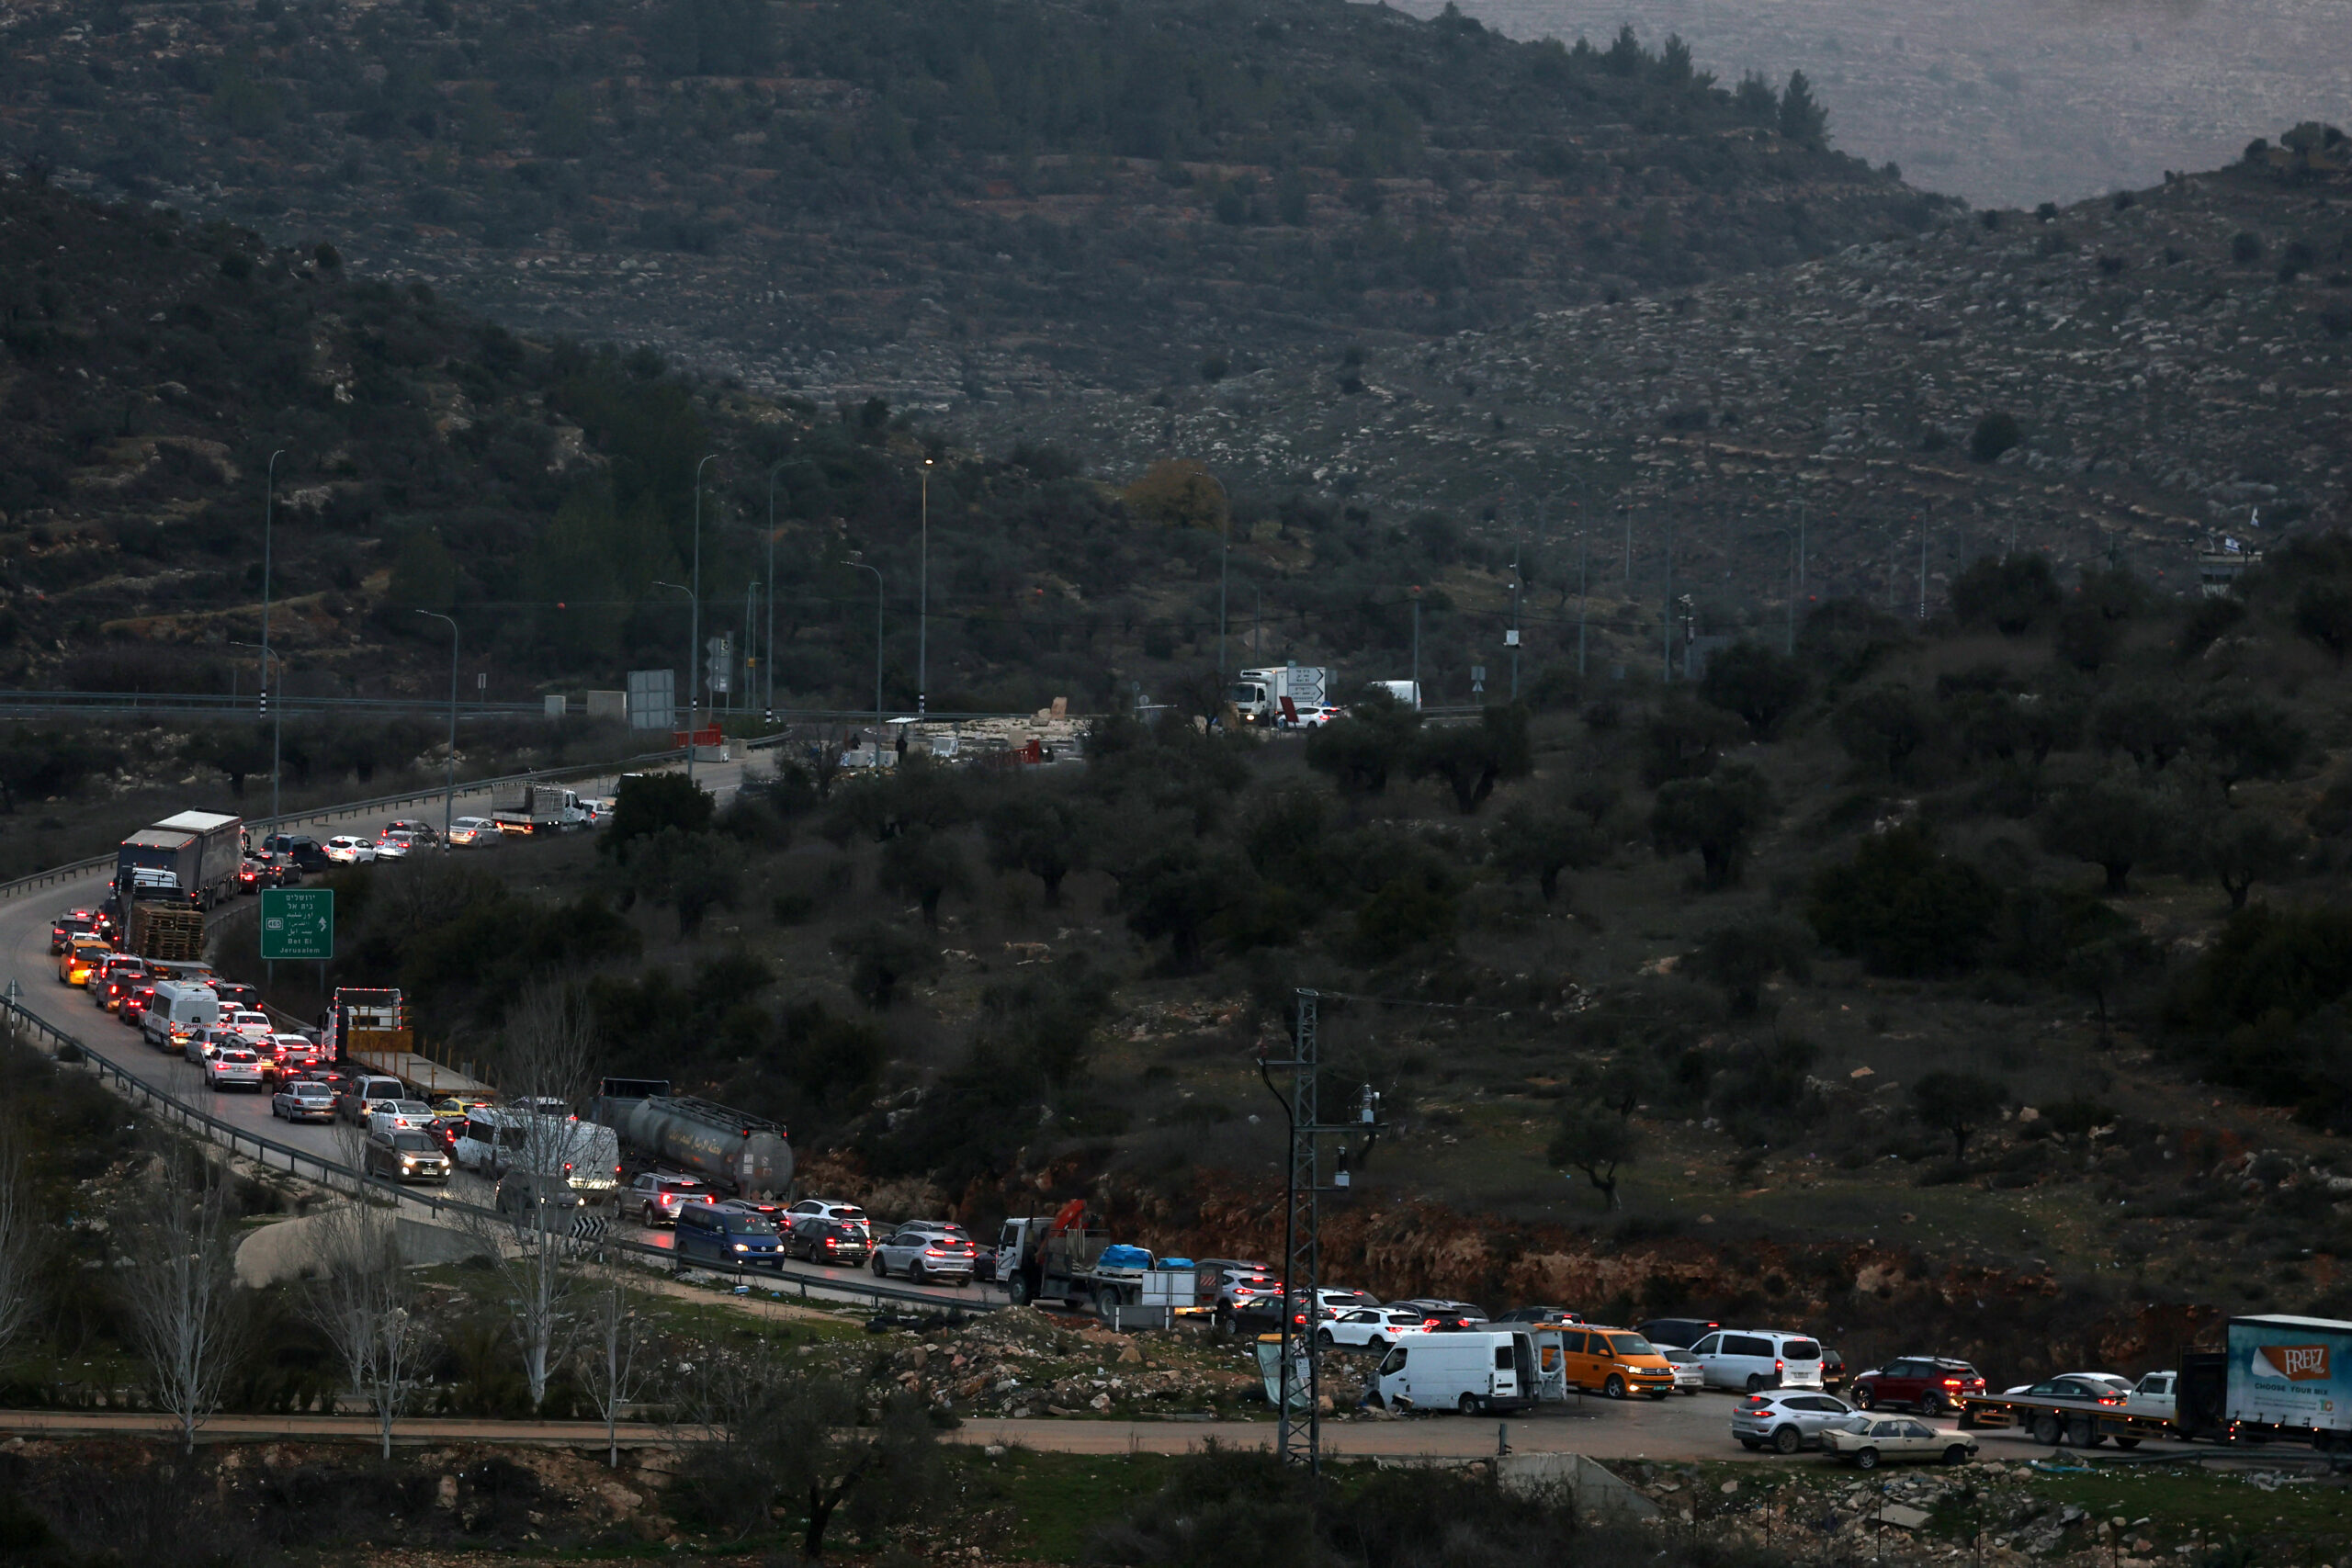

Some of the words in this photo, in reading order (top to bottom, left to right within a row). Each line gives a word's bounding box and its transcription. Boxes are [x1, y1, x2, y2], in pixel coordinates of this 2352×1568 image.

[2284, 1348, 2324, 1375] FREEZ
[2255, 1382, 2287, 1392] CHOOSE
[2290, 1386, 2312, 1394] YOUR
